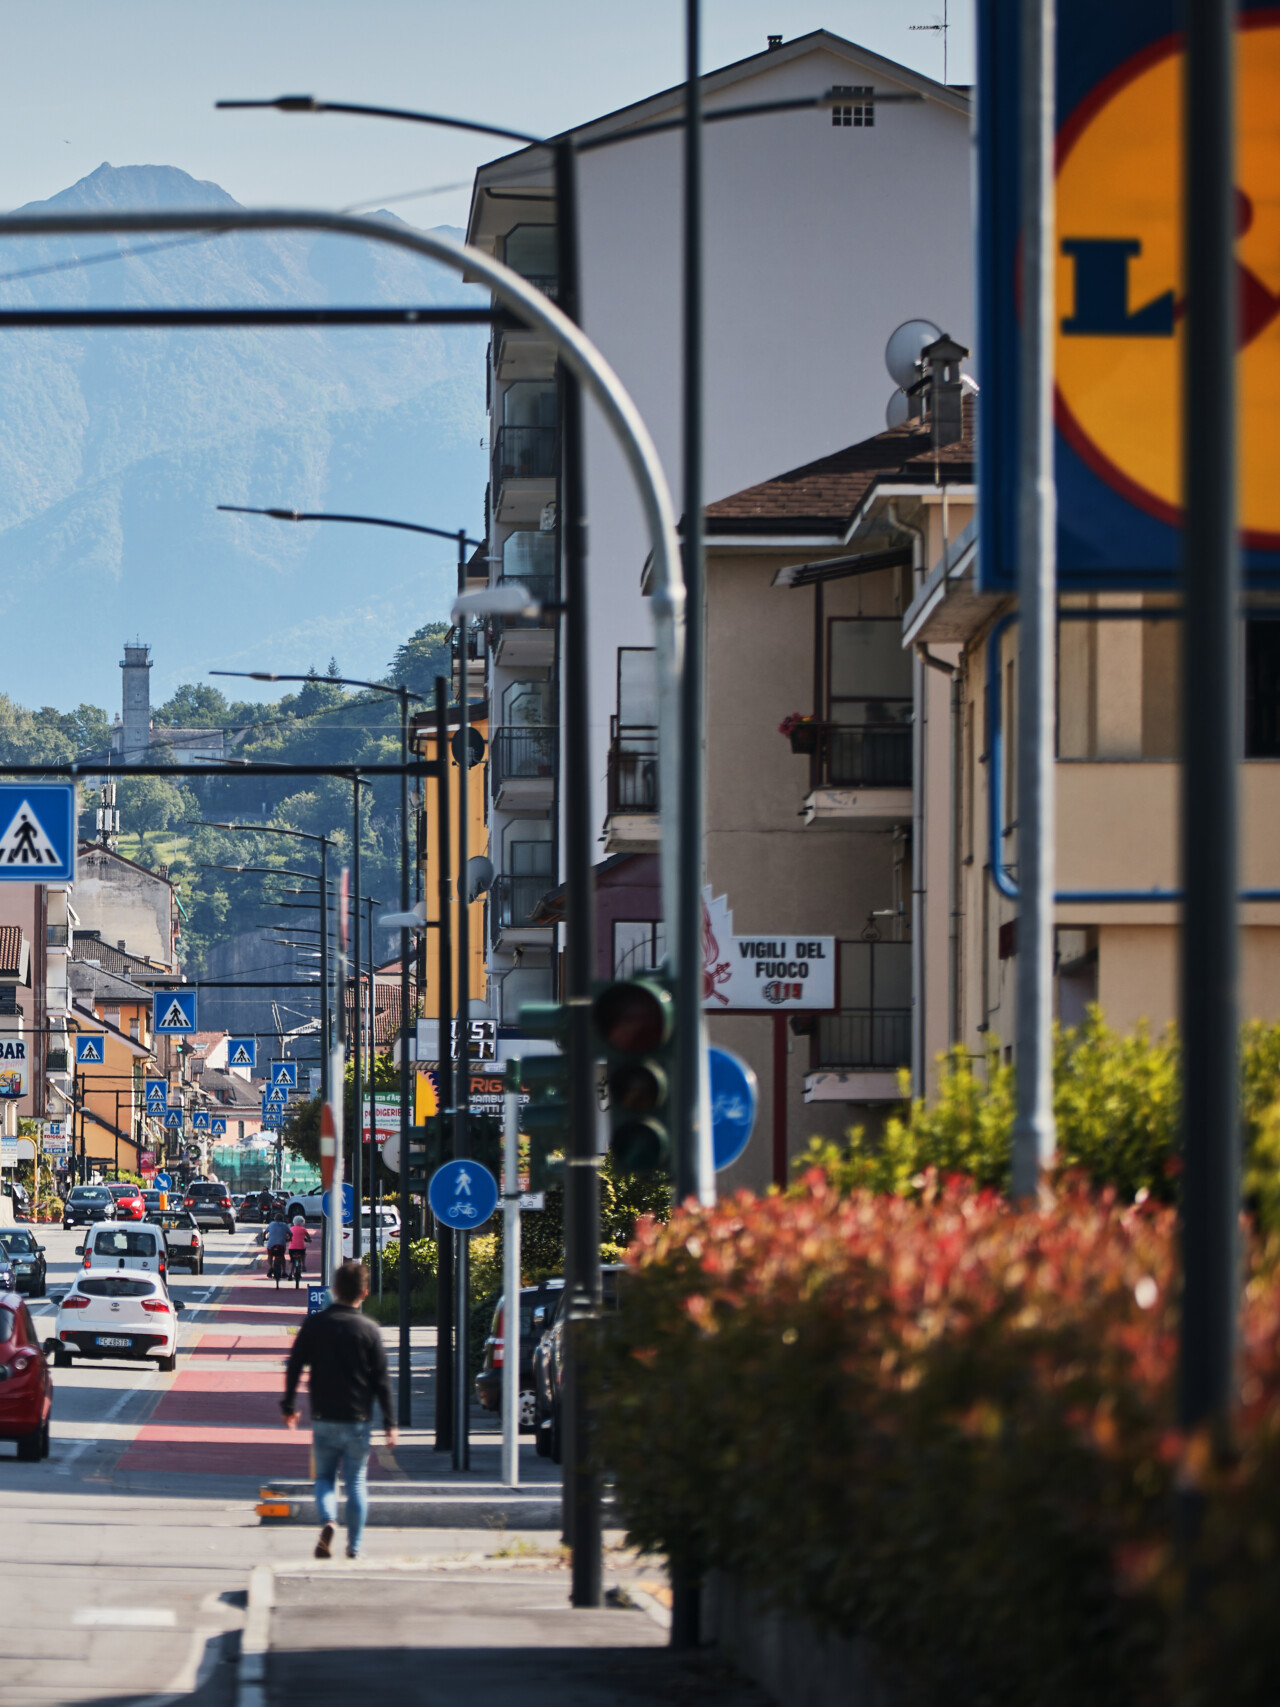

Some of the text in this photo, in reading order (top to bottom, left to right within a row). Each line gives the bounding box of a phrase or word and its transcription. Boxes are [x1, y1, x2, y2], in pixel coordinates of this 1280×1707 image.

[739, 942, 826, 959] VIGILI DEL
[755, 962, 810, 979] FUOCO
[773, 983, 803, 999] 115
[468, 1094, 531, 1104] HAMBUER
[375, 1108, 412, 1117] DIGERIBE
